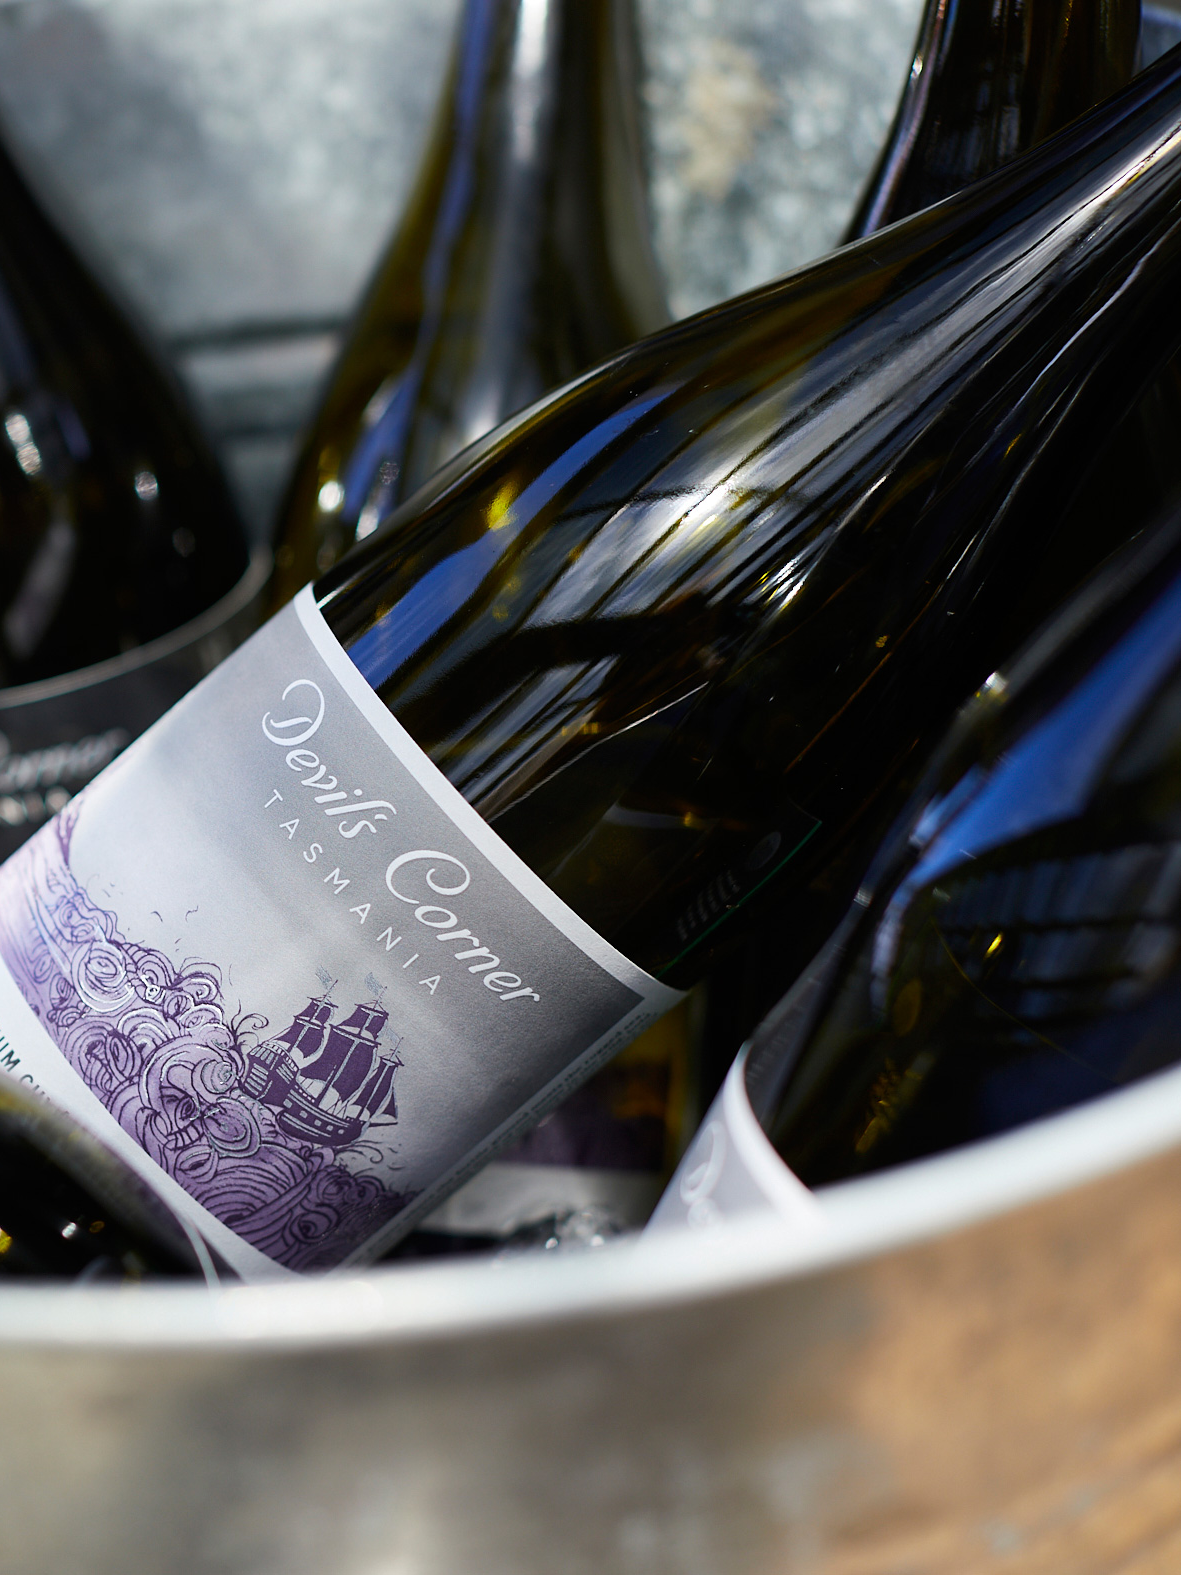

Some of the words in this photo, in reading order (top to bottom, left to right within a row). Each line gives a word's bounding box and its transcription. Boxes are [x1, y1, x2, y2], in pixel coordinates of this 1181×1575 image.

[261, 678, 397, 839] Devil's
[385, 849, 541, 1002] Corner
[263, 788, 442, 996] TASMANIA
